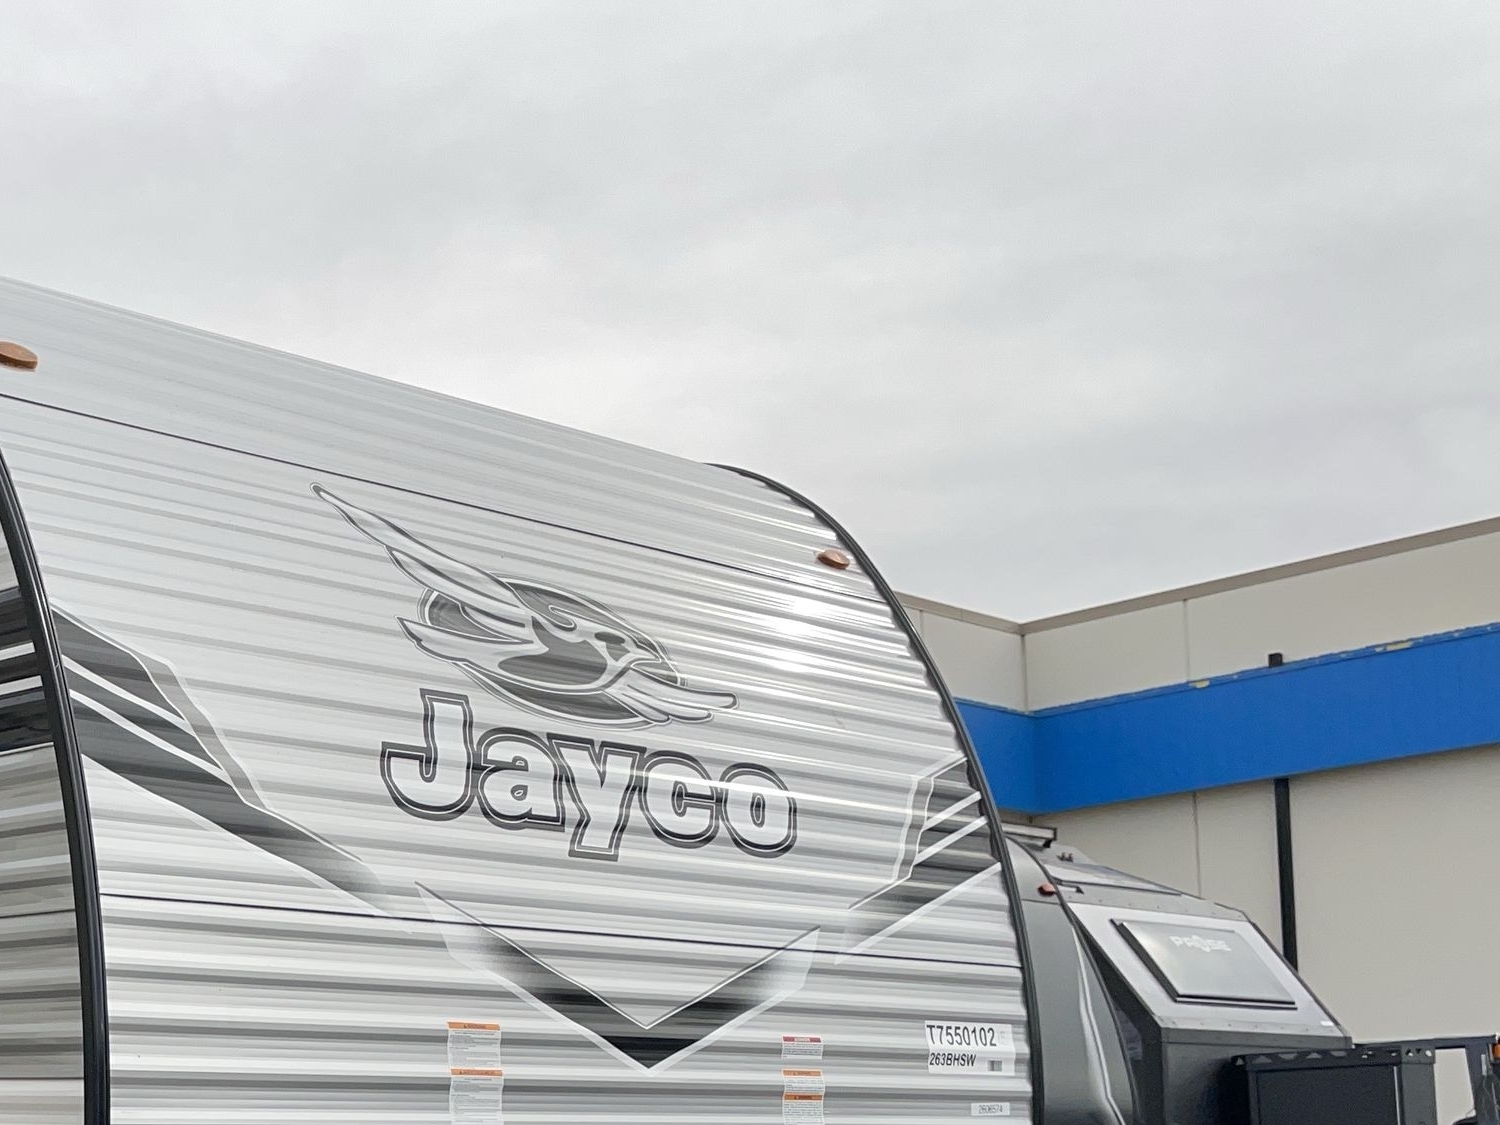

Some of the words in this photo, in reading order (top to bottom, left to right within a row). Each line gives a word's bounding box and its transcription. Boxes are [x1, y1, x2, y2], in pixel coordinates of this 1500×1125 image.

[379, 687, 798, 862] Jayco
[926, 1024, 997, 1047] T7550102
[929, 1052, 977, 1067] 263BHSW
